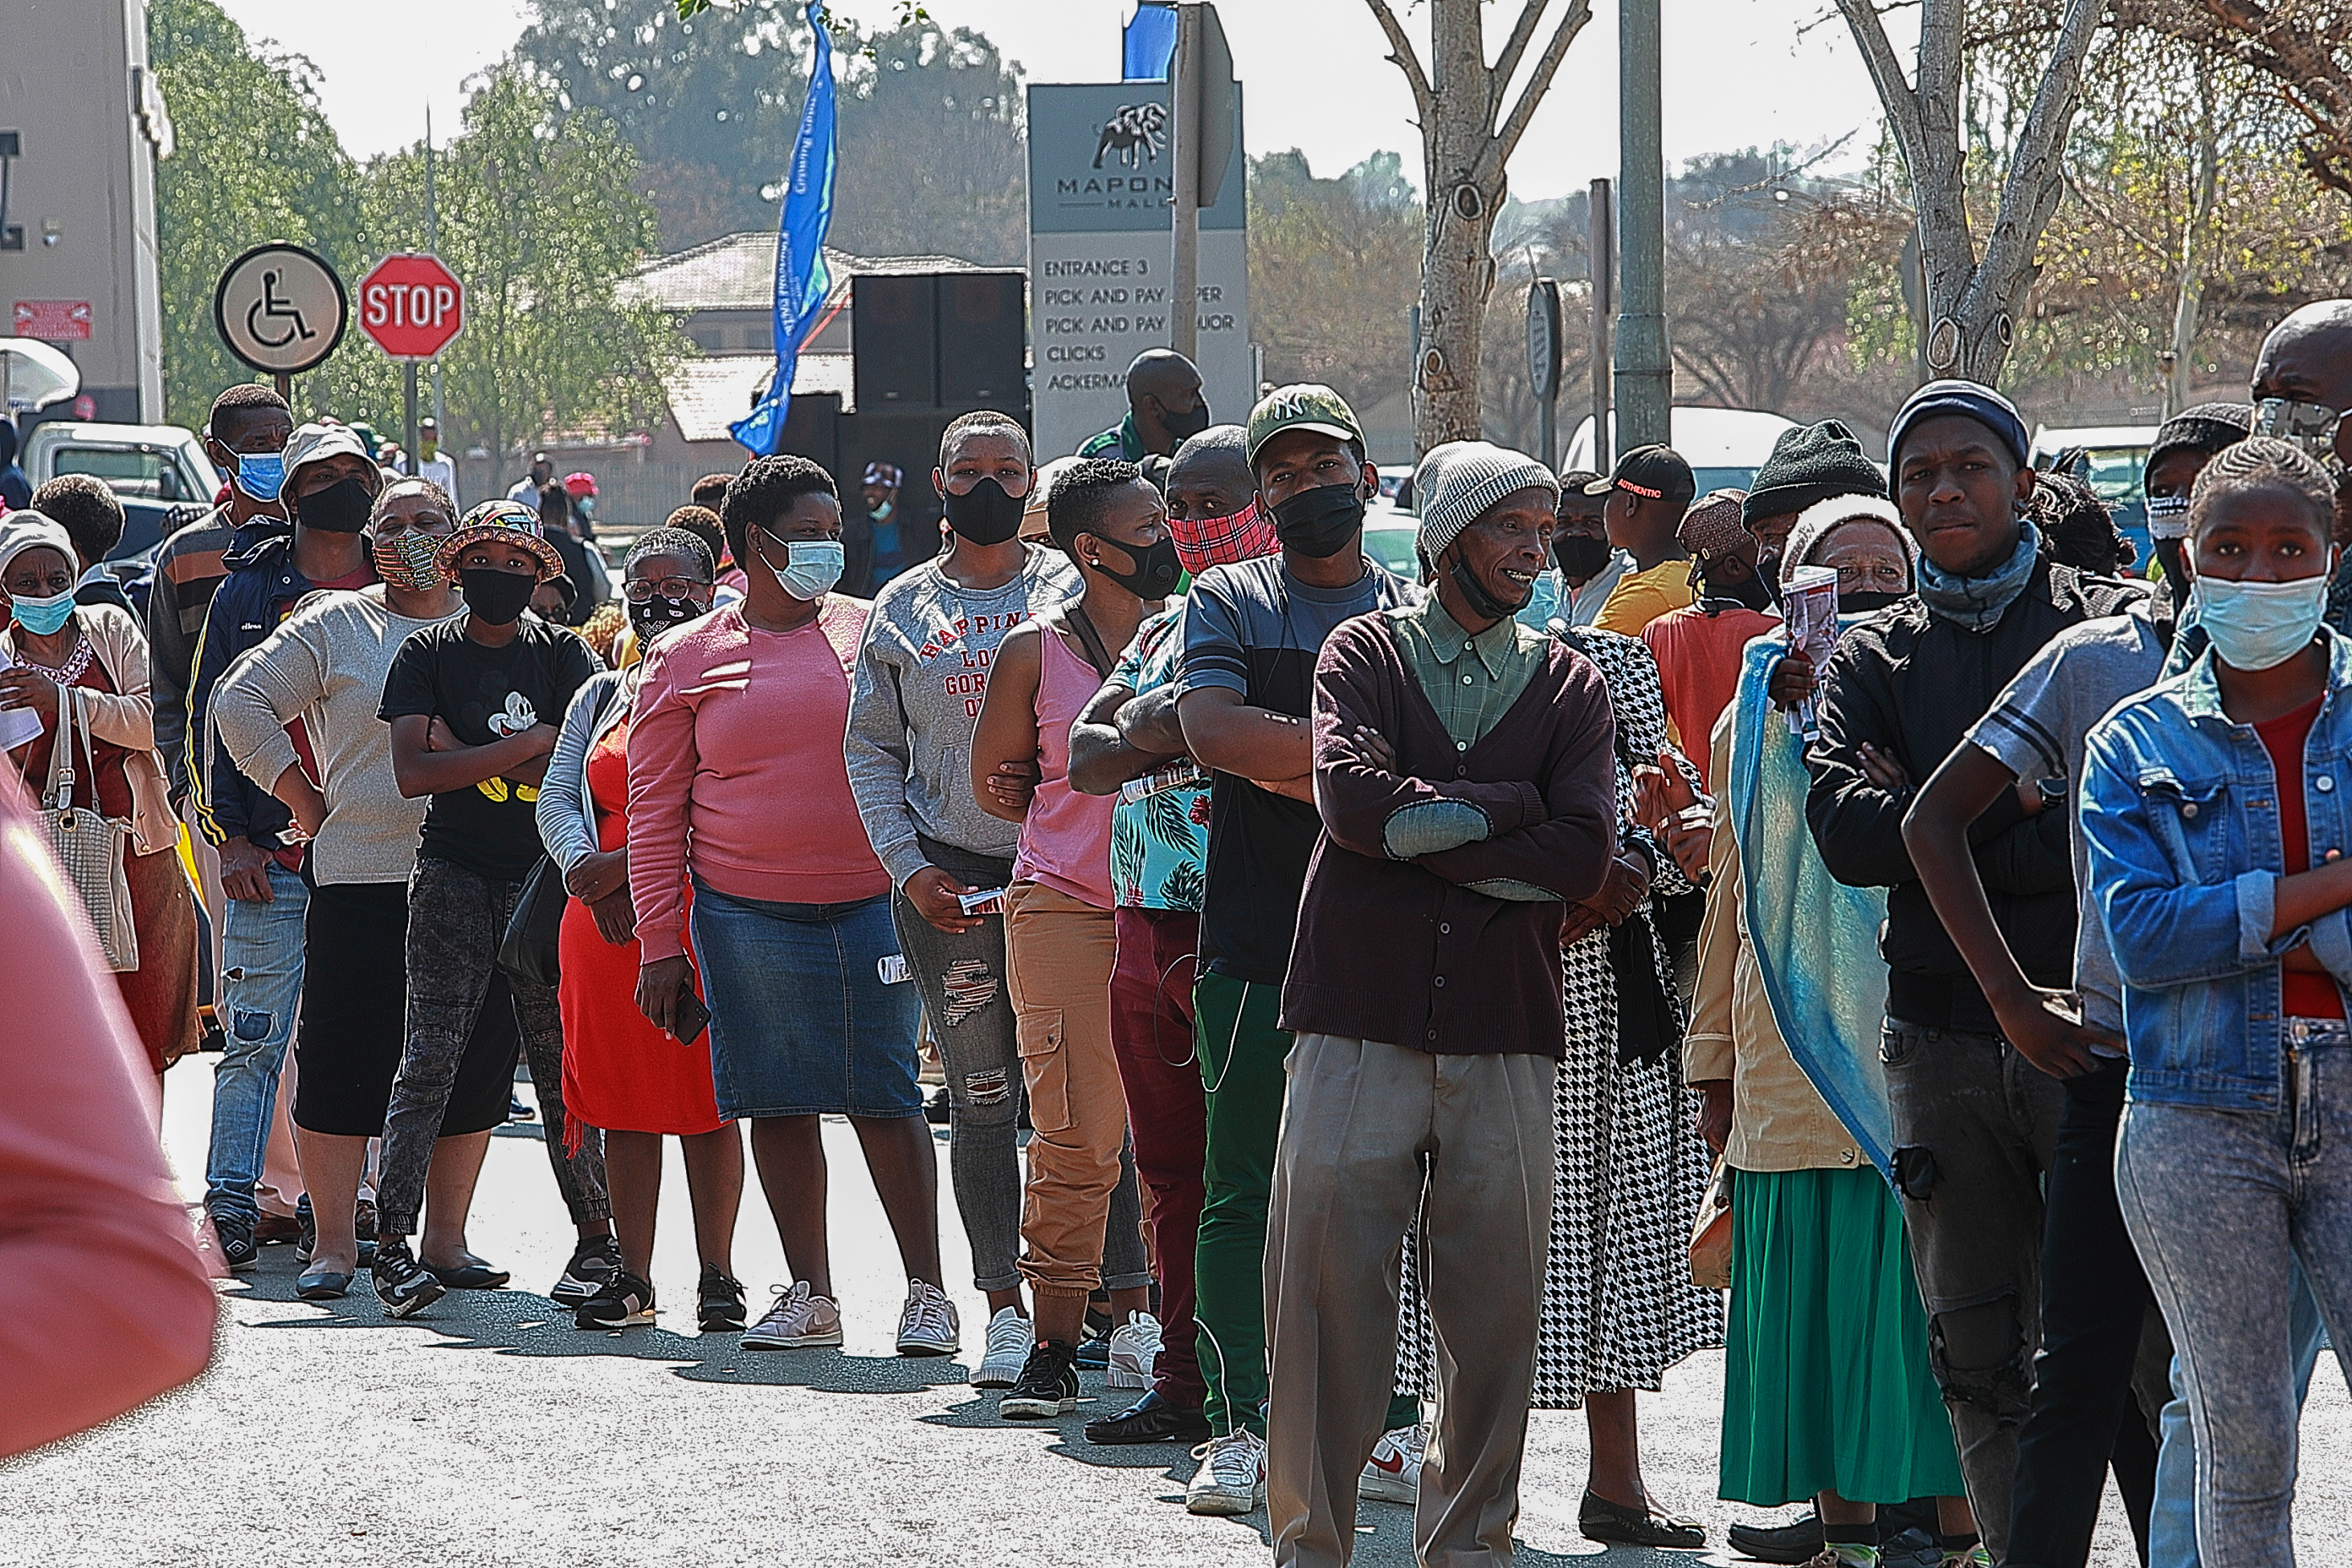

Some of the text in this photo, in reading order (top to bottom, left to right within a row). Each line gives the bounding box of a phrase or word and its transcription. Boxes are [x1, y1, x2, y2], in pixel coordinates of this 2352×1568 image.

[1056, 177, 1173, 193] MAPON
[1107, 198, 1169, 208] MALL
[1044, 259, 1149, 276] ENTRANCE 3
[1044, 285, 1223, 305] PICK AND PAY PER
[366, 284, 455, 328] STOP
[1045, 314, 1235, 335] PICK AND PAY UOR
[1046, 345, 1106, 362] CLICKS
[1047, 374, 1126, 391] ACKERMA
[1617, 478, 1662, 499] AUTHENTIC
[919, 611, 1037, 660] HAPPIN
[945, 672, 986, 696] GOR
